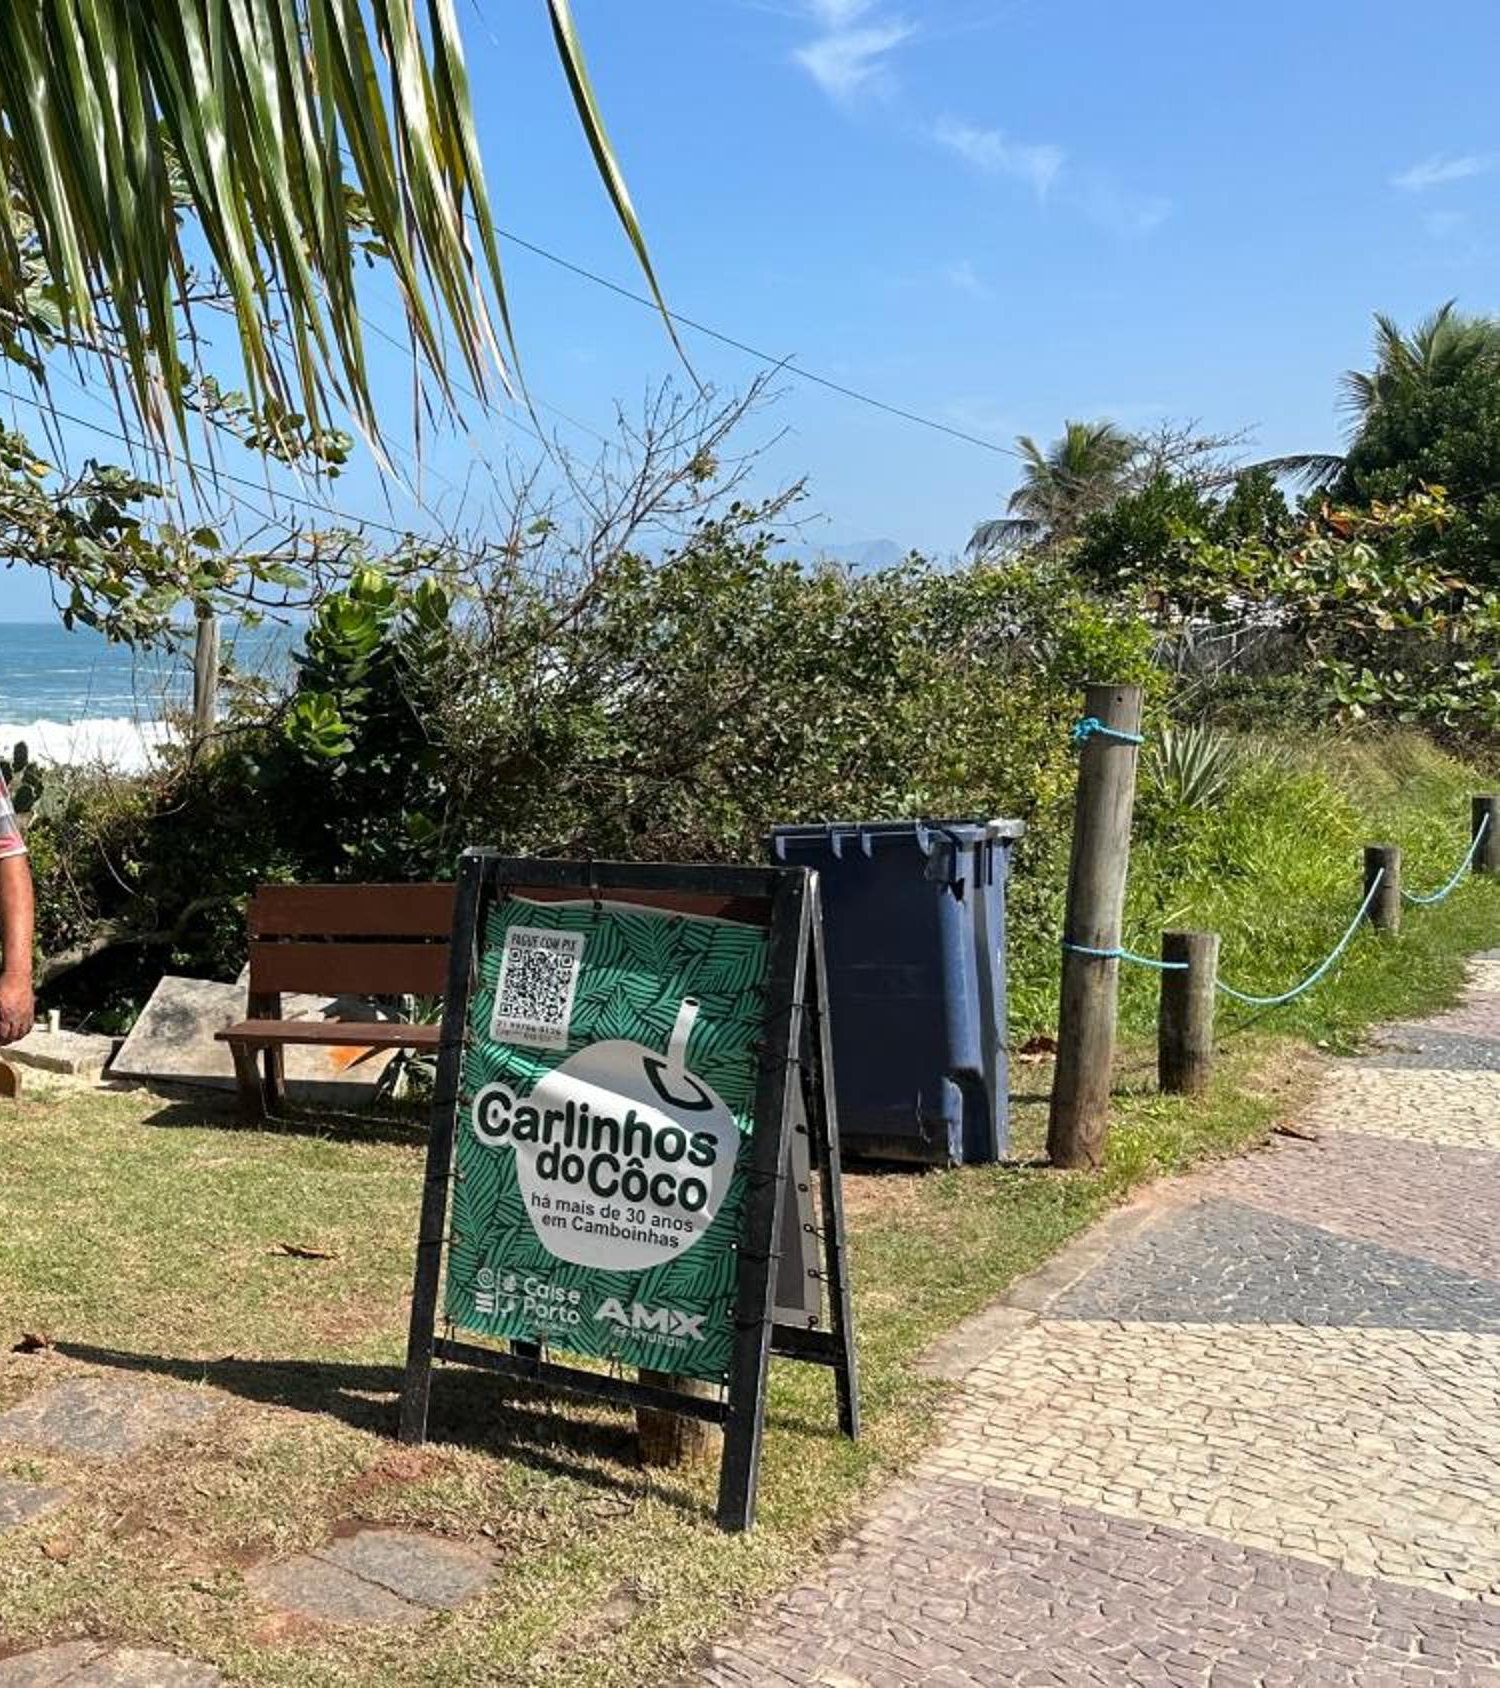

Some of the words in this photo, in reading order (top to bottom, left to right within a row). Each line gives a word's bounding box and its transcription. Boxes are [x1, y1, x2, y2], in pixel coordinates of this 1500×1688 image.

[477, 1090, 718, 1168] Carlinhos
[536, 1142, 585, 1185] do
[588, 1152, 708, 1212] Côco
[531, 1192, 550, 1209] há
[555, 1198, 596, 1216] mais
[600, 1203, 621, 1221] de
[626, 1207, 646, 1225] 30
[651, 1213, 694, 1233] anos
[541, 1214, 567, 1228] em
[571, 1216, 679, 1249] Camboinhas
[523, 1295, 580, 1324] Porto
[593, 1297, 708, 1341] AMX
